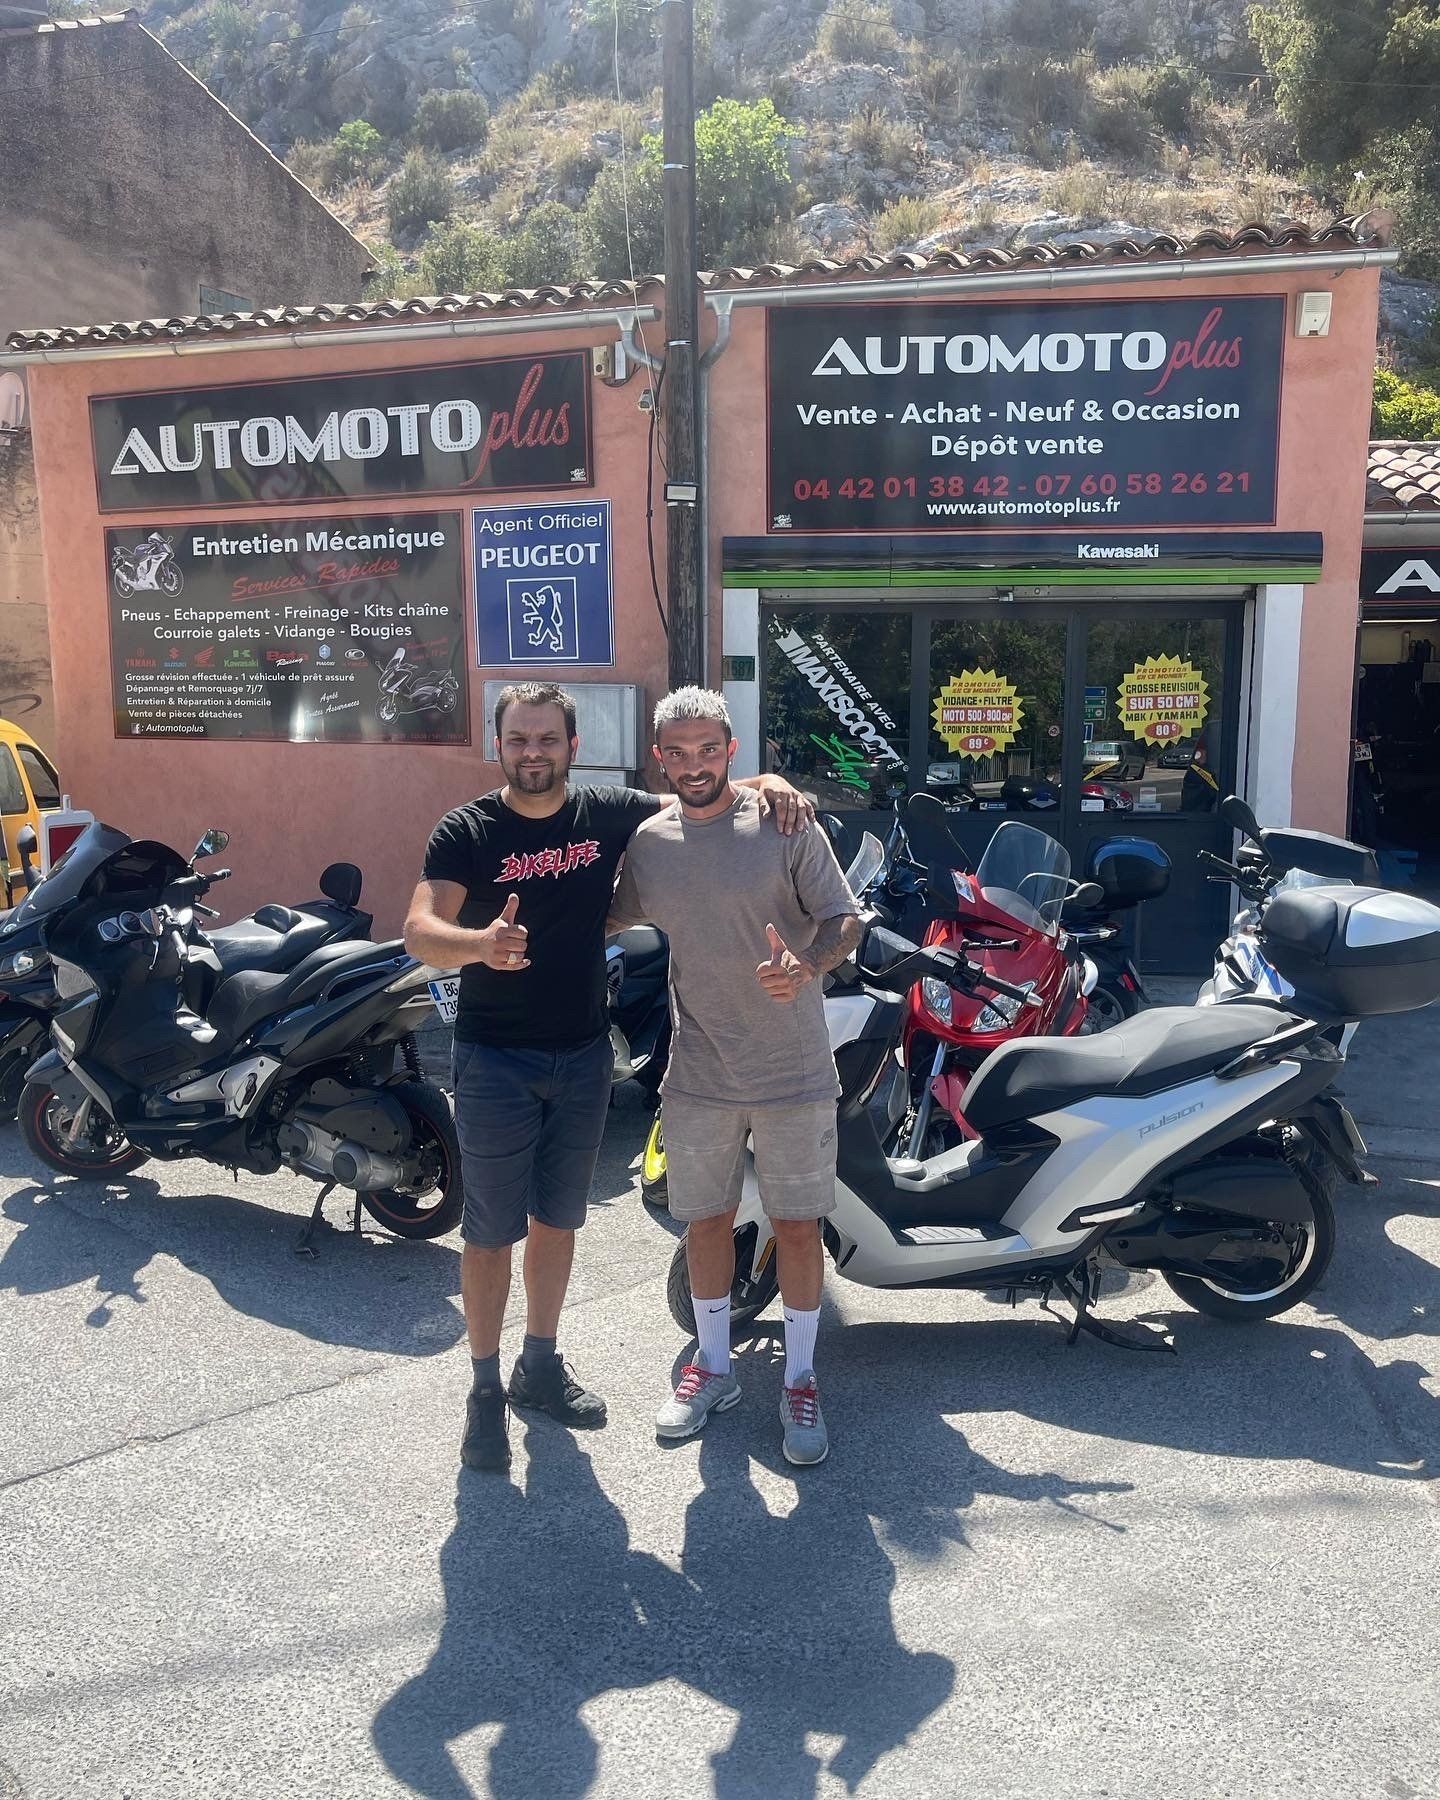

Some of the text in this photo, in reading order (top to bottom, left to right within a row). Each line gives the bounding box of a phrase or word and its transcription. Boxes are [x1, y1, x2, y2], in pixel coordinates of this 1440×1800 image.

[812, 306, 1242, 396] AUTOMOTO plus
[797, 404, 877, 425] Vente
[901, 402, 981, 424] Achat
[1006, 400, 1074, 423] Neuf
[1082, 401, 1104, 422] &
[1111, 398, 1240, 422] Occasion
[110, 363, 570, 487] AUTOMOTO plus
[931, 434, 1104, 461] Dépôt vente
[794, 479, 830, 501] 04
[838, 478, 875, 499] 42
[884, 477, 916, 498] 01
[928, 476, 964, 497] 38
[973, 476, 1009, 497] 42
[1035, 475, 1072, 496] 07
[1080, 474, 1117, 495] 60
[1126, 473, 1162, 494] 58
[1171, 473, 1208, 494] 26
[1217, 472, 1250, 493] 21
[926, 498, 1121, 518] www.automotoplus.fr
[480, 512, 603, 536] Agent Officiel
[192, 528, 445, 556] Entretien Mécanique
[1077, 543, 1160, 560] Kawasaki
[481, 543, 601, 569] PEUGEOT
[318, 556, 400, 582] Rapides
[121, 609, 161, 622] Pneus
[174, 607, 271, 623] Echappement
[285, 606, 349, 621] Freinage
[364, 604, 393, 617] Kits
[398, 603, 449, 617] chaîne
[154, 626, 213, 640] Courroie
[218, 625, 261, 641] galets
[274, 625, 335, 640] Vidange
[350, 623, 412, 639] Bougies
[125, 673, 154, 681] Grosse
[157, 672, 190, 681] révision
[192, 672, 233, 681] effectuée
[241, 673, 246, 681] 1
[249, 673, 286, 681] véhicule
[288, 673, 300, 681] de
[303, 673, 322, 683] prêt
[325, 673, 355, 681] assuré
[811, 633, 897, 731] PARTENAIRE AVEC
[126, 684, 263, 694] Dépannage et Remorquage 7j/7
[1160, 682, 1200, 693] REVISION
[127, 698, 166, 706] Entretien
[177, 697, 224, 707] Réparation
[234, 698, 272, 706] domicile
[983, 696, 1013, 705] FILTRE
[1130, 697, 1154, 710] SUR
[1157, 696, 1173, 709] 50
[128, 709, 243, 719] Vente de pièces détachées
[943, 709, 965, 721] MOTO
[1125, 713, 1146, 722] MBK
[1156, 711, 1199, 721] YAMAHA
[146, 723, 204, 733] Automotoplus
[947, 725, 971, 734] POINTS
[971, 725, 980, 734] DE
[493, 839, 602, 883] BIKELIFE
[442, 982, 459, 998] BG
[1136, 1100, 1205, 1139] pulsion
